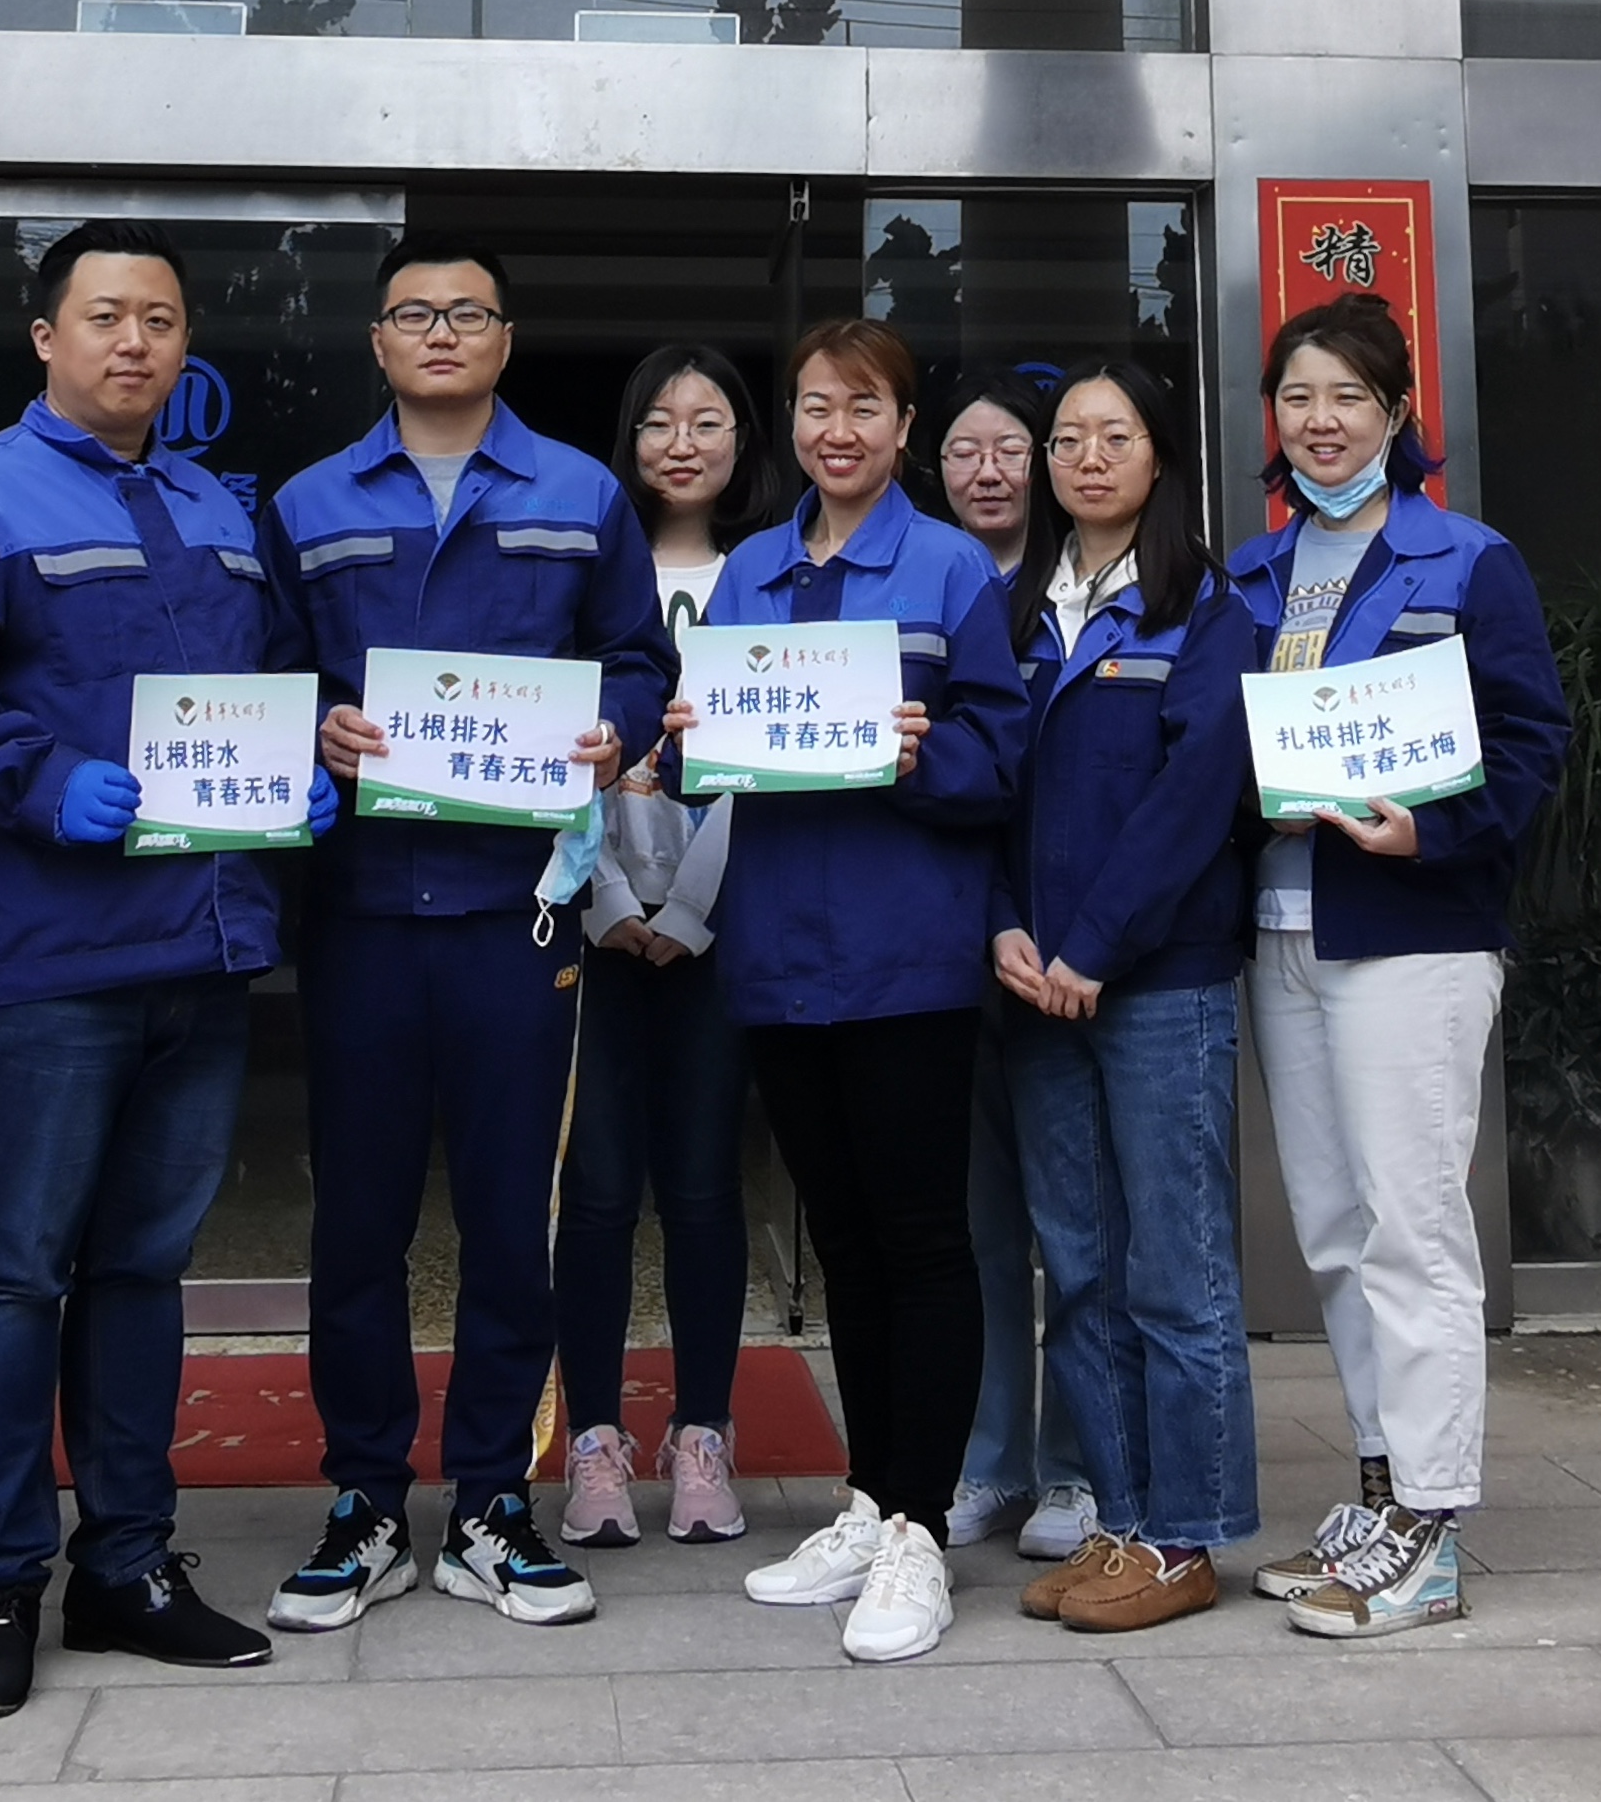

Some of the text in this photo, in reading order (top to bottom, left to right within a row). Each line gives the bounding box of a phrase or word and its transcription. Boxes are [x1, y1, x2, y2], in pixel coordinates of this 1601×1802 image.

[1300, 221, 1381, 288] 精
[707, 685, 820, 715] 扎根排水
[389, 711, 508, 746] 扎根排水
[765, 720, 879, 750] 青春无悔
[1276, 714, 1395, 750] 扎根排水
[144, 739, 239, 770] 扎根排水
[448, 752, 569, 787] 青春无悔
[1341, 730, 1457, 780] 青春无悔
[193, 775, 290, 807] 青春无悔
